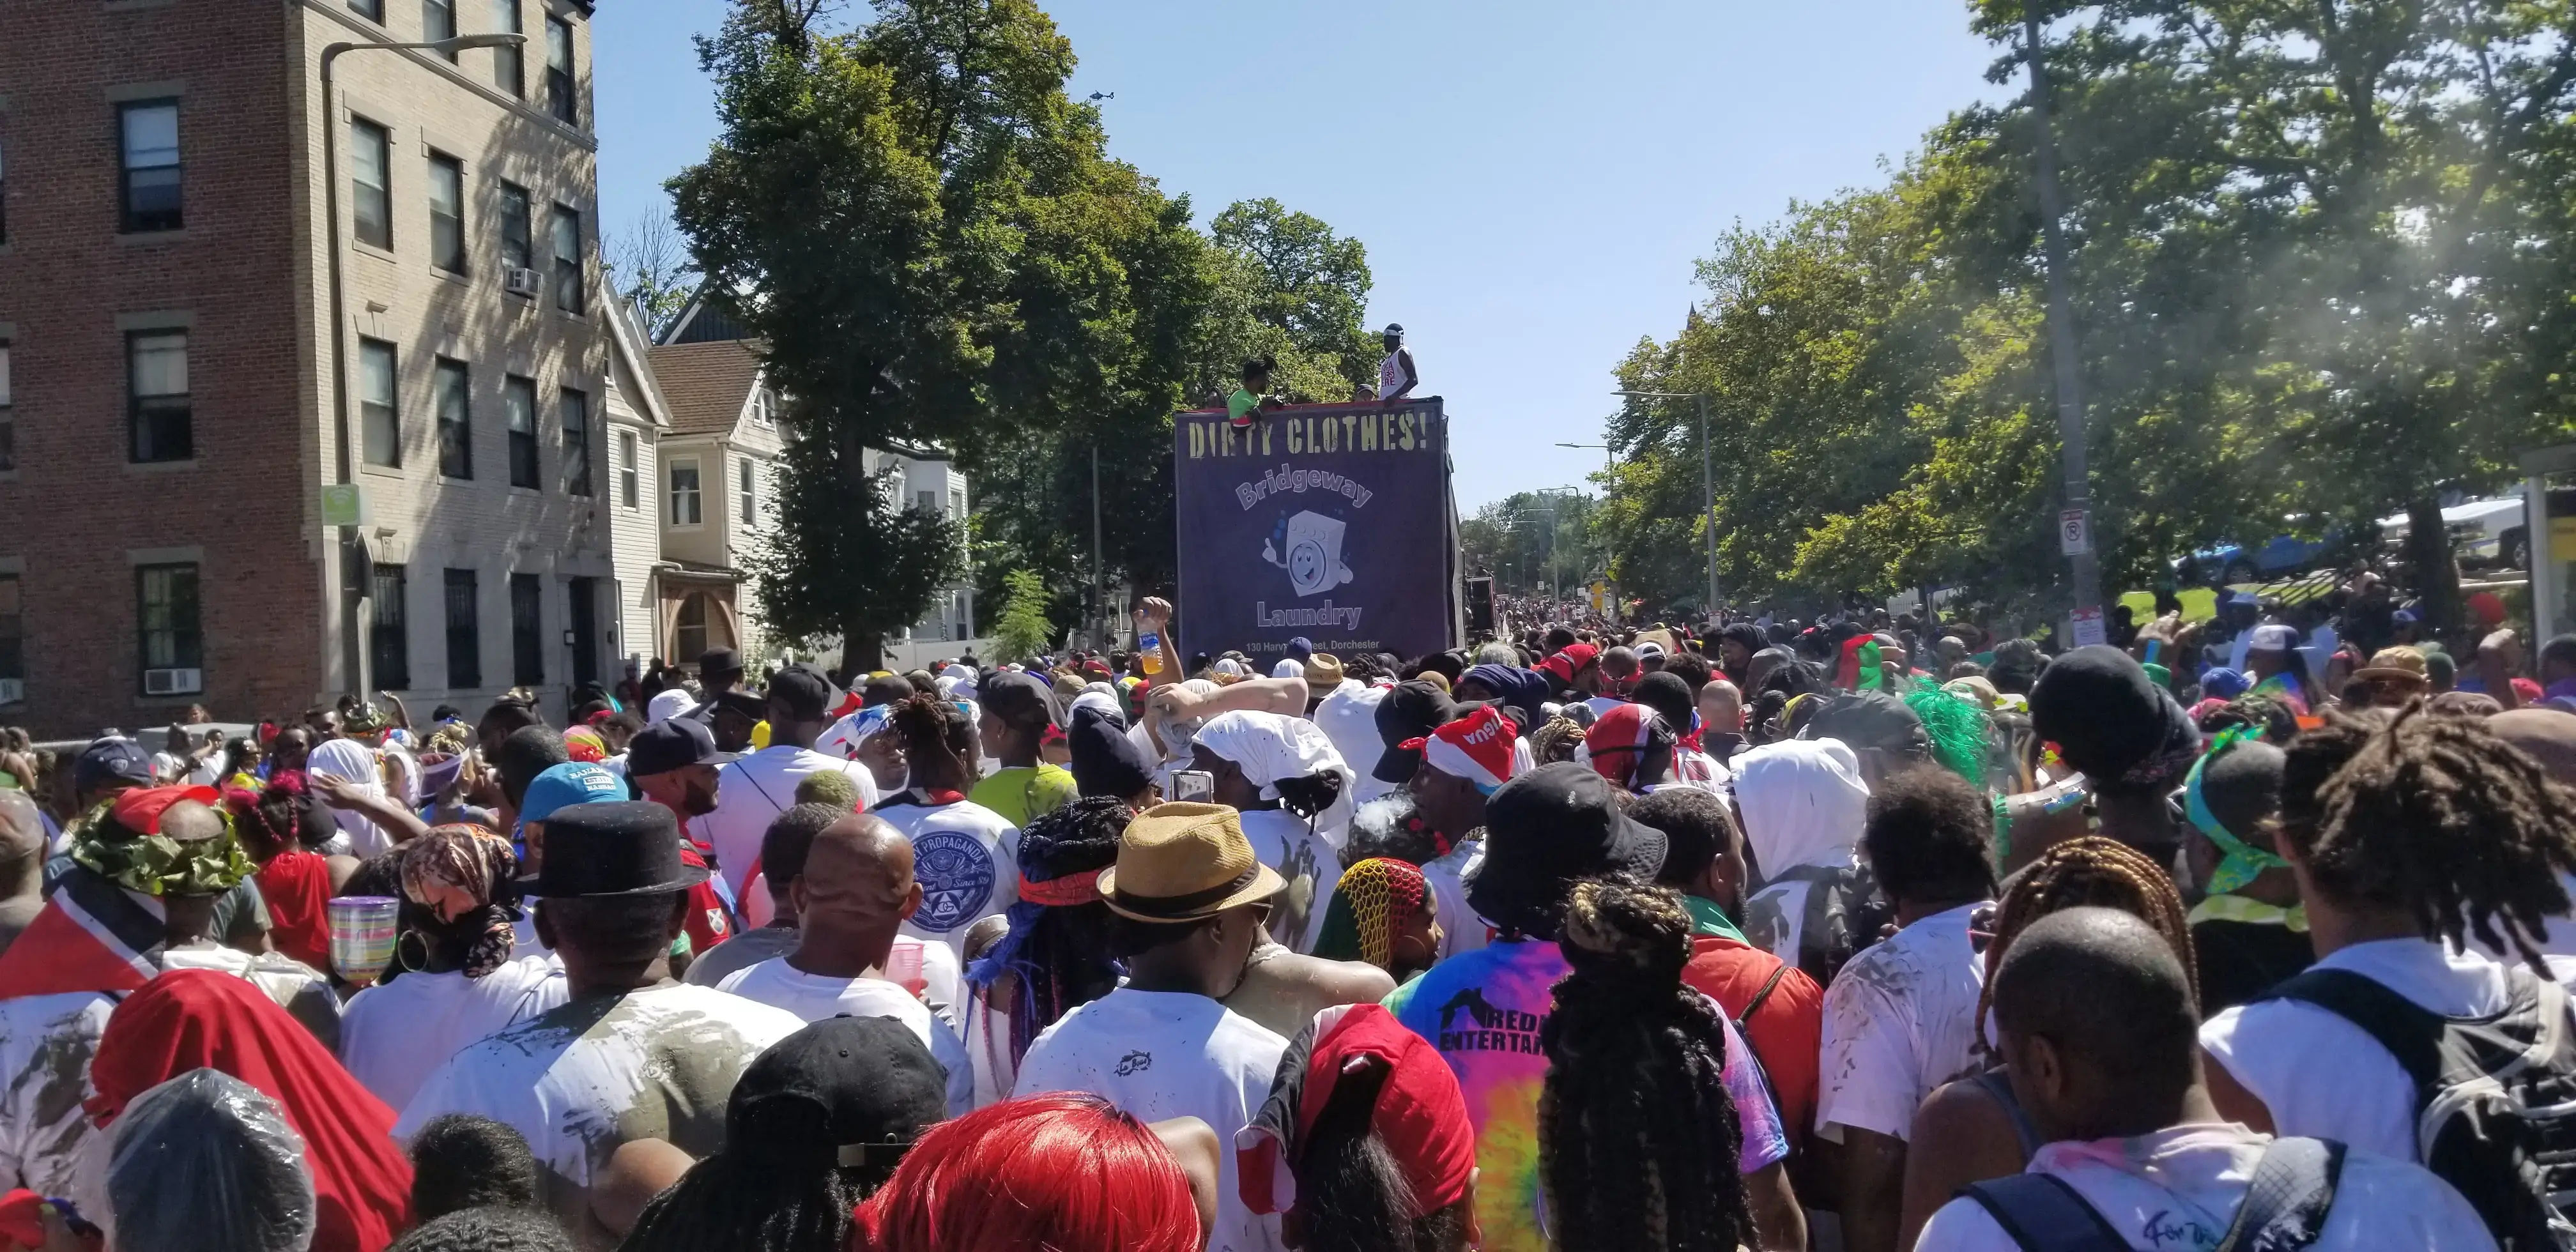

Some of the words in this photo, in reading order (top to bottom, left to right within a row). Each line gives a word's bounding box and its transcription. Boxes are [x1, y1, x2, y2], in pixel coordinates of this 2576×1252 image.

[1188, 422, 1273, 459] DIRTY
[1287, 411, 1426, 454] CLOTHES!
[1235, 463, 1373, 510] Bridgeway
[1257, 599, 1362, 630] Laundry
[1246, 643, 1261, 652] 130
[1331, 639, 1379, 650] Dorchester
[921, 837, 985, 862] PROPAGANDA
[953, 878, 976, 888] Since
